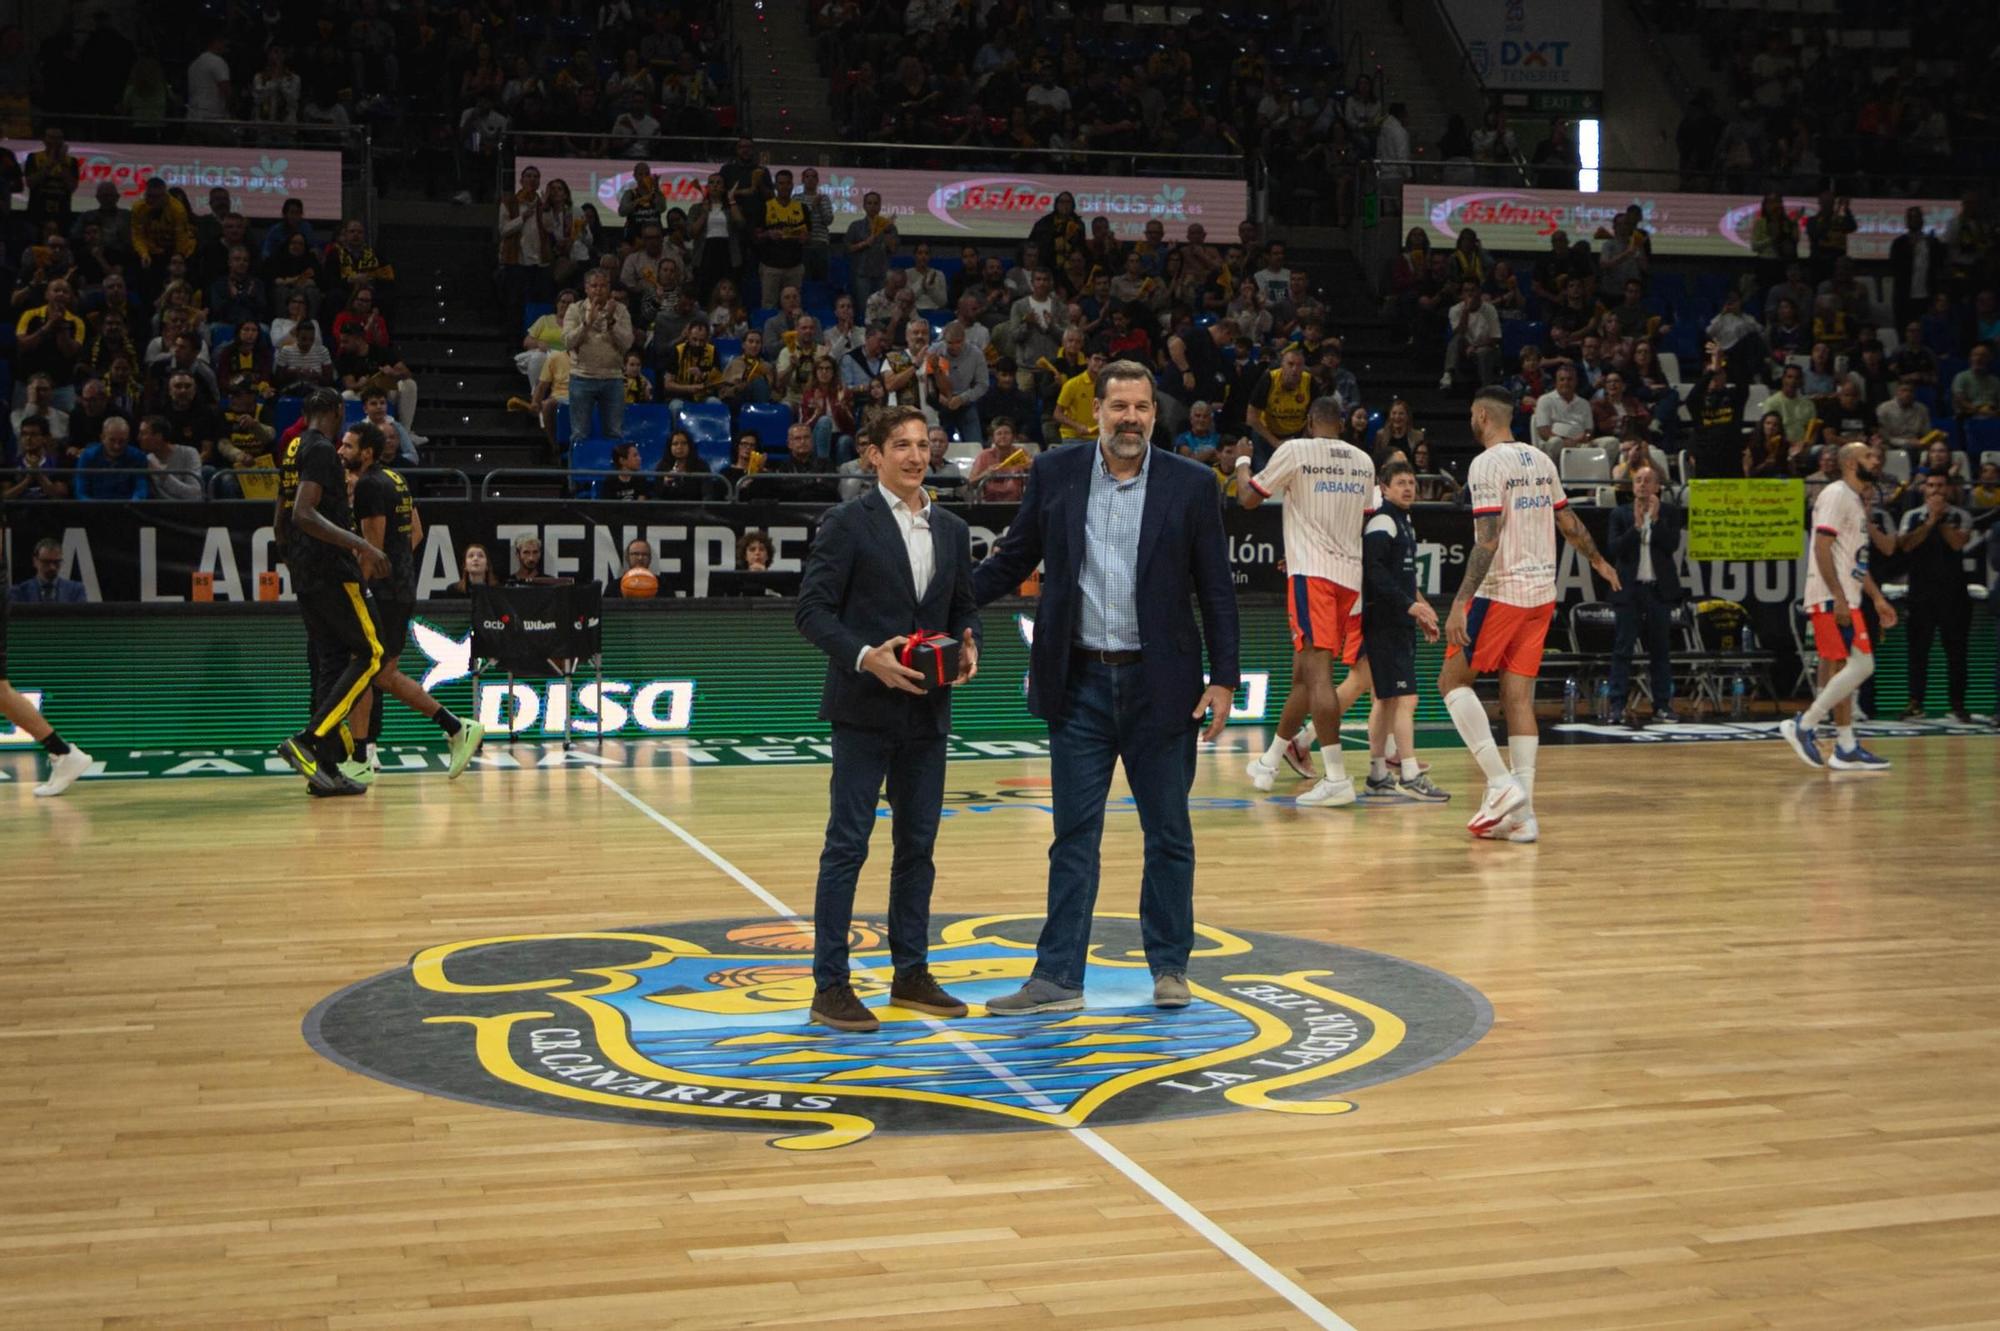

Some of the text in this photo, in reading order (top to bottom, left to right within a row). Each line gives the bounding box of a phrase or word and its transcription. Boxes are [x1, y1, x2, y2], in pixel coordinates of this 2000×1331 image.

[1502, 41, 1569, 66] DXT
[483, 619, 557, 631] acb Wilson
[1156, 1070, 1258, 1094] LA
[1250, 1012, 1359, 1071] LAGUNA
[539, 1053, 838, 1111] CANARIAS
